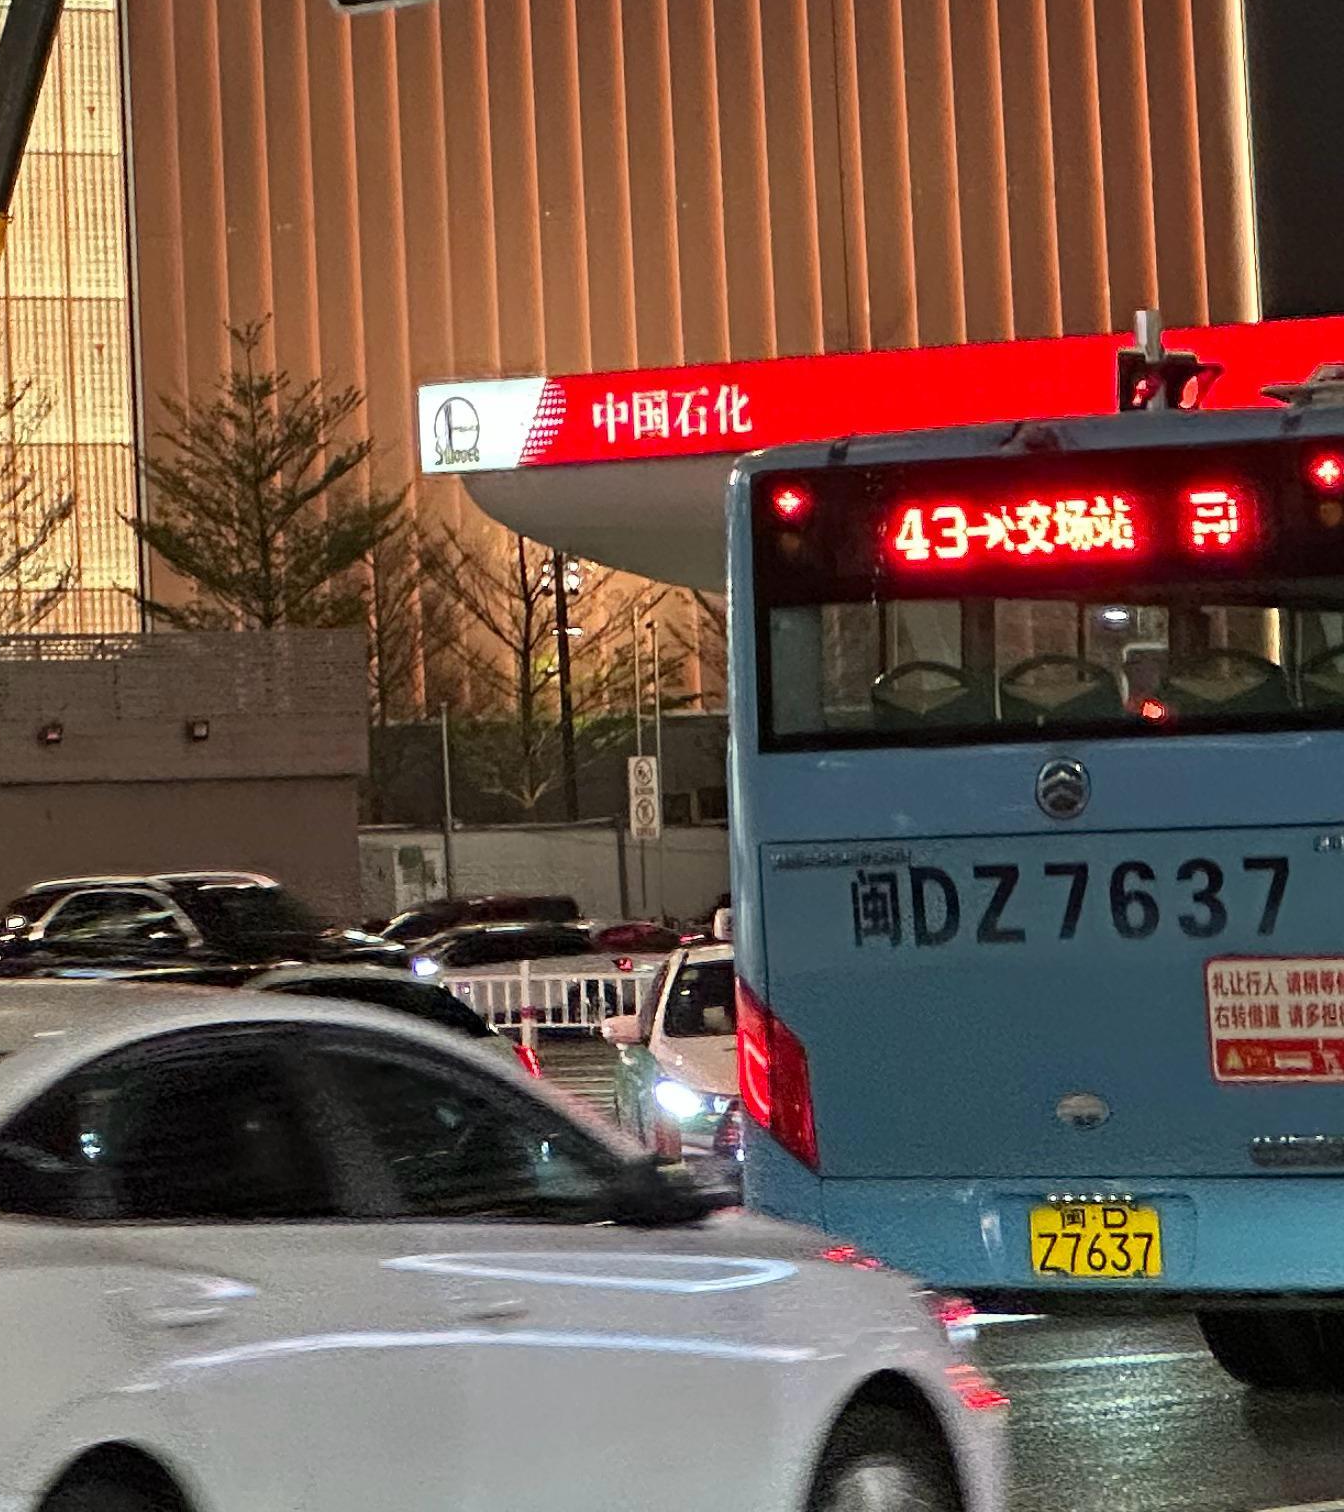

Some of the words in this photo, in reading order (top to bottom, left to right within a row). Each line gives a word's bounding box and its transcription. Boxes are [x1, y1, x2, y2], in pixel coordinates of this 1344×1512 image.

[592, 384, 754, 443] 中国石化
[895, 506, 968, 561] 43
[851, 856, 1290, 947] 闽DZ7637
[1213, 970, 1279, 997] 礼让行人
[1214, 1003, 1281, 1029] 右转借道
[1037, 1231, 1154, 1273] Z7637
